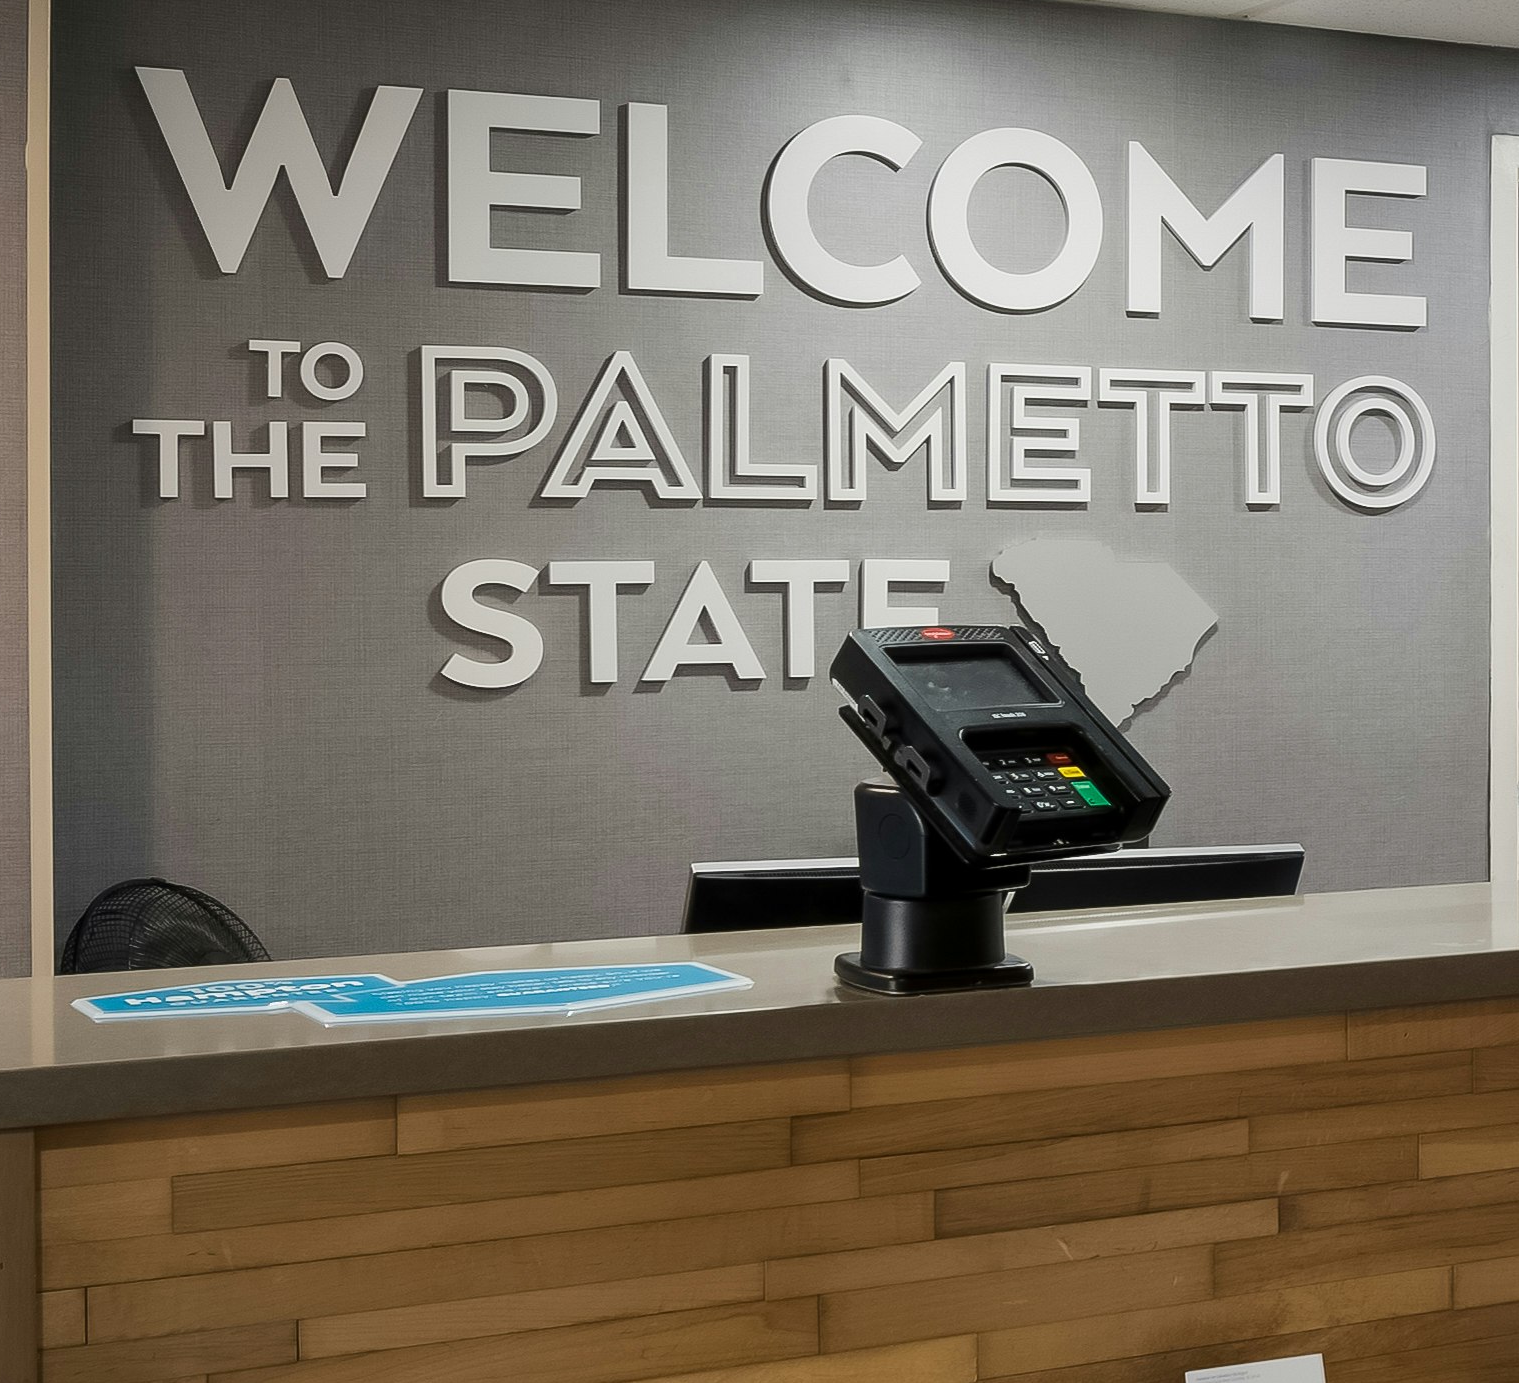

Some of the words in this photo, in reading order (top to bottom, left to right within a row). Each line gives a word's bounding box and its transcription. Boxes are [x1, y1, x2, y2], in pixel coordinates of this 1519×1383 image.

[134, 65, 1427, 327] WELCOME
[132, 418, 367, 499] THE
[421, 344, 1437, 509] PALMETTO
[248, 338, 364, 401] TO
[124, 981, 364, 1006] Hampton
